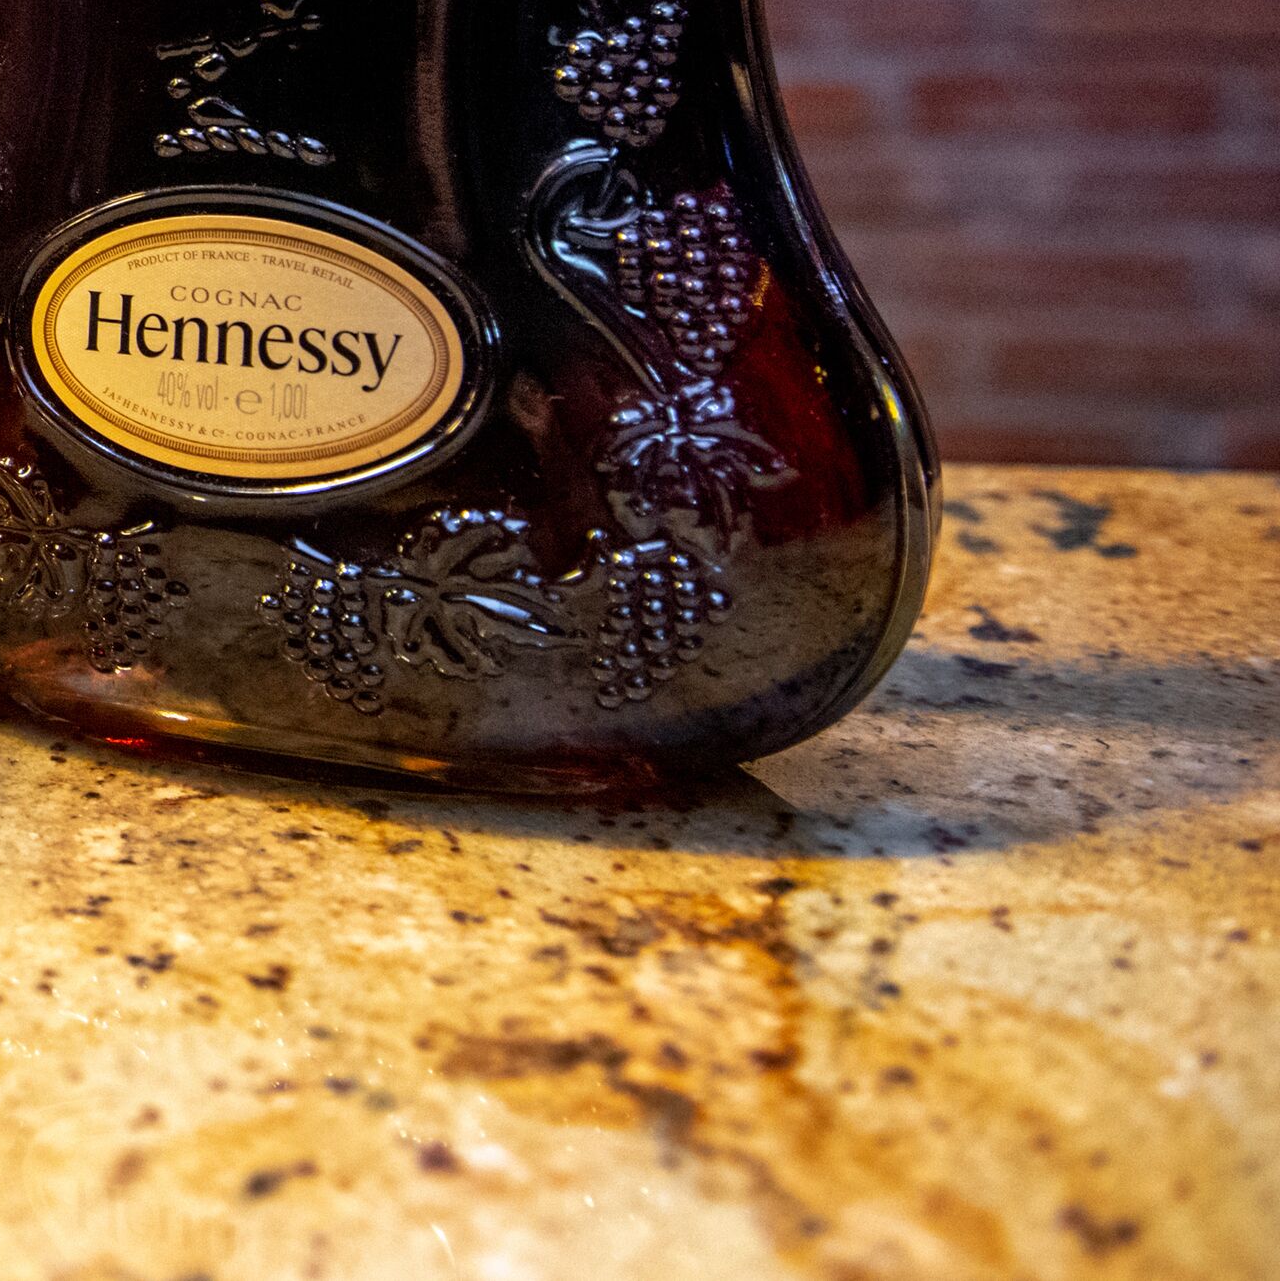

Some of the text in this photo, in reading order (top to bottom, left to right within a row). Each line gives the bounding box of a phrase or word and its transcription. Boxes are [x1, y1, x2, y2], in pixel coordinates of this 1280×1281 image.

[127, 250, 355, 290] PRODUCT OF FRANCE TRAVEL RETAIL
[170, 285, 303, 312] COGNAC
[84, 290, 404, 393] Hennessy
[157, 371, 191, 408] 40%
[196, 376, 219, 411] vol
[122, 398, 195, 432] HENNESSY
